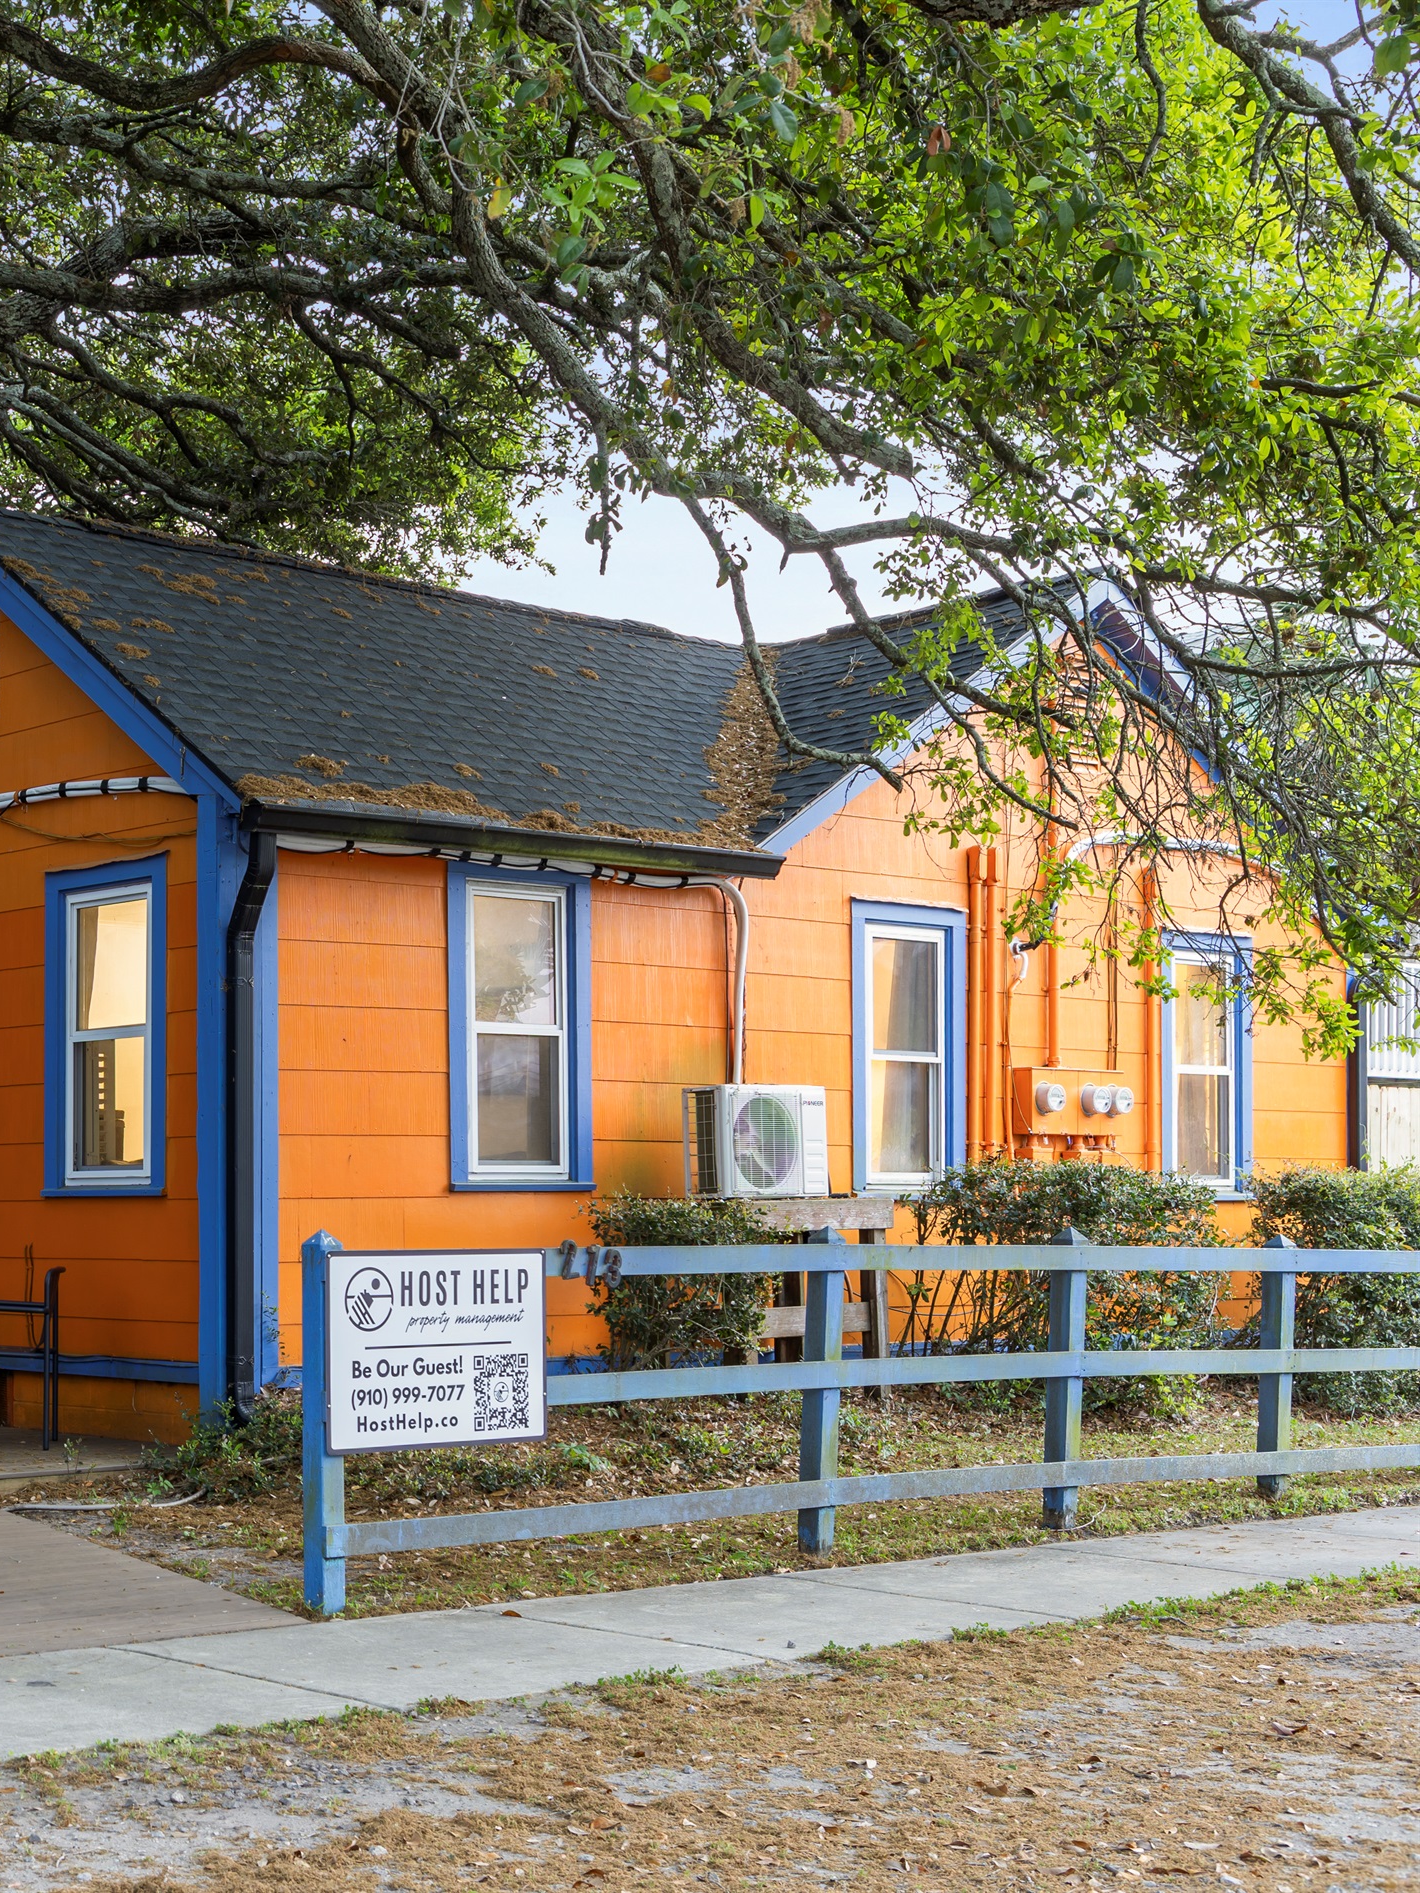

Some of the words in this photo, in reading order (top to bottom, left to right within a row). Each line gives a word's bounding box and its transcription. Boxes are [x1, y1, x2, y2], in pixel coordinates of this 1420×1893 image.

[560, 1239, 622, 1288] 213
[400, 1270, 461, 1307] HOST
[473, 1268, 529, 1305] HELP
[405, 1310, 450, 1333] property
[455, 1308, 525, 1331] management
[352, 1360, 372, 1379] Be
[376, 1358, 408, 1378] Our
[413, 1355, 464, 1376] Guest!
[351, 1388, 388, 1411] (910)
[392, 1384, 465, 1405] 999-7077
[357, 1412, 459, 1433] HostHelp.co
